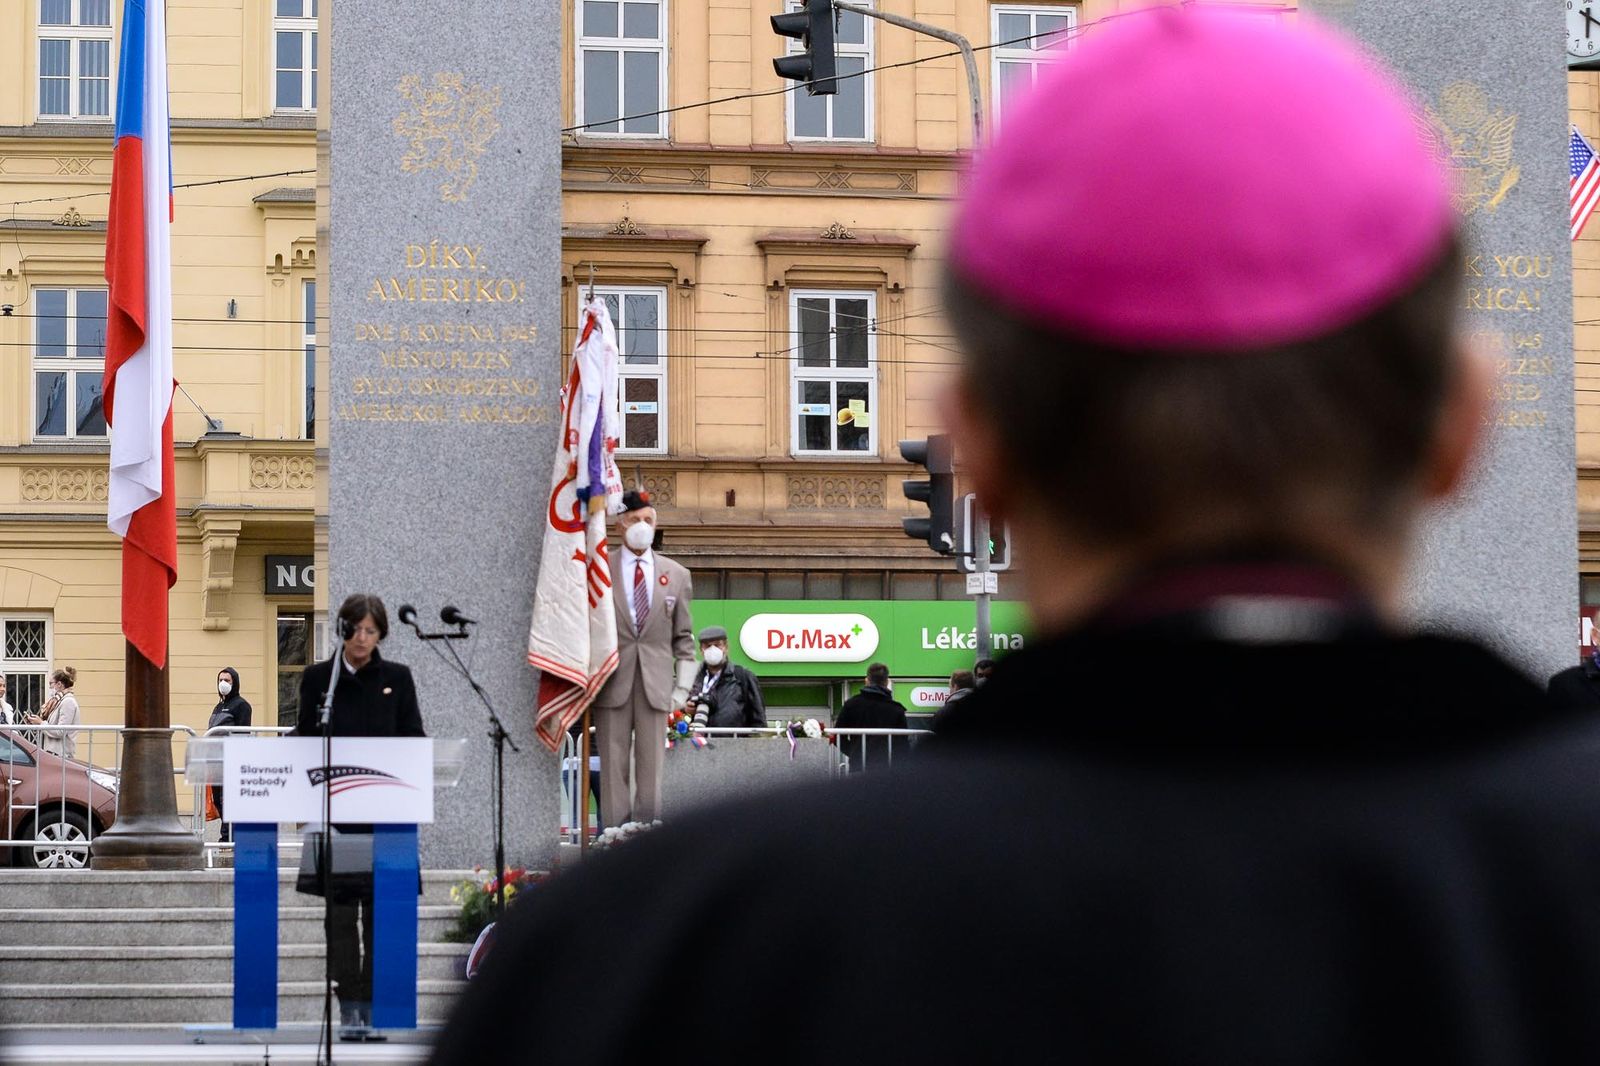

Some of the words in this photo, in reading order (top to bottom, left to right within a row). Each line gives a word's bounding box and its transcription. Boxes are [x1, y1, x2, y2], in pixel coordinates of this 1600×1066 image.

[1495, 255, 1552, 278] YOU
[367, 277, 526, 303] AMERIKO!
[1466, 287, 1541, 311] RICA!
[355, 323, 394, 341] DNE
[767, 629, 852, 650] Dr.Max
[921, 626, 1024, 650] Lékána
[240, 764, 293, 774] Slavnosti
[240, 776, 287, 788] svobody
[240, 787, 270, 797] Plzeň
